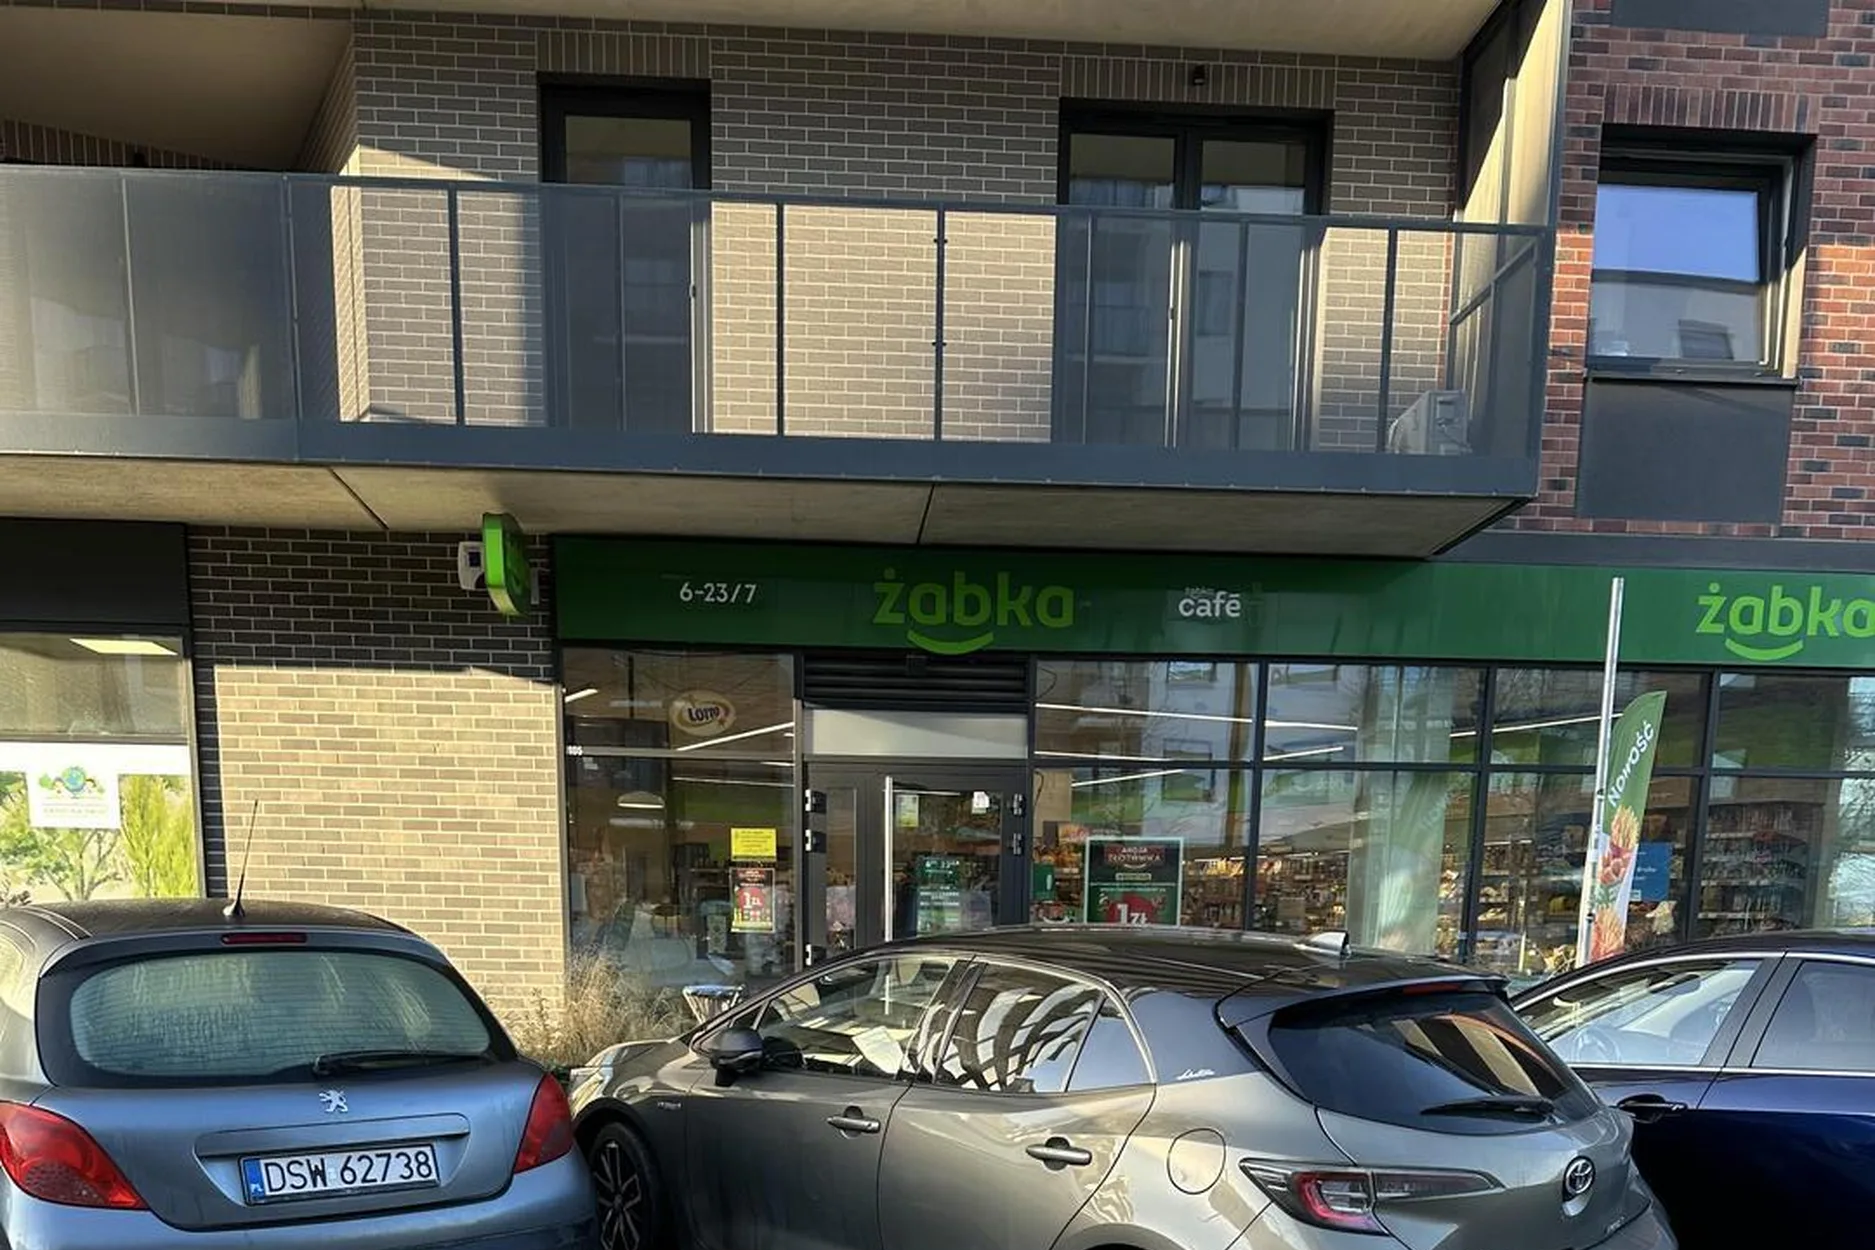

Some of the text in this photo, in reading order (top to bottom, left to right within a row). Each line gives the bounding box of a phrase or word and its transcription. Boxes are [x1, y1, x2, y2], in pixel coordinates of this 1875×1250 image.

[680, 582, 756, 603] 6-23/7
[873, 568, 1074, 628] żabka
[1696, 582, 1875, 638] żabka
[264, 1151, 432, 1193] DSW 62738
